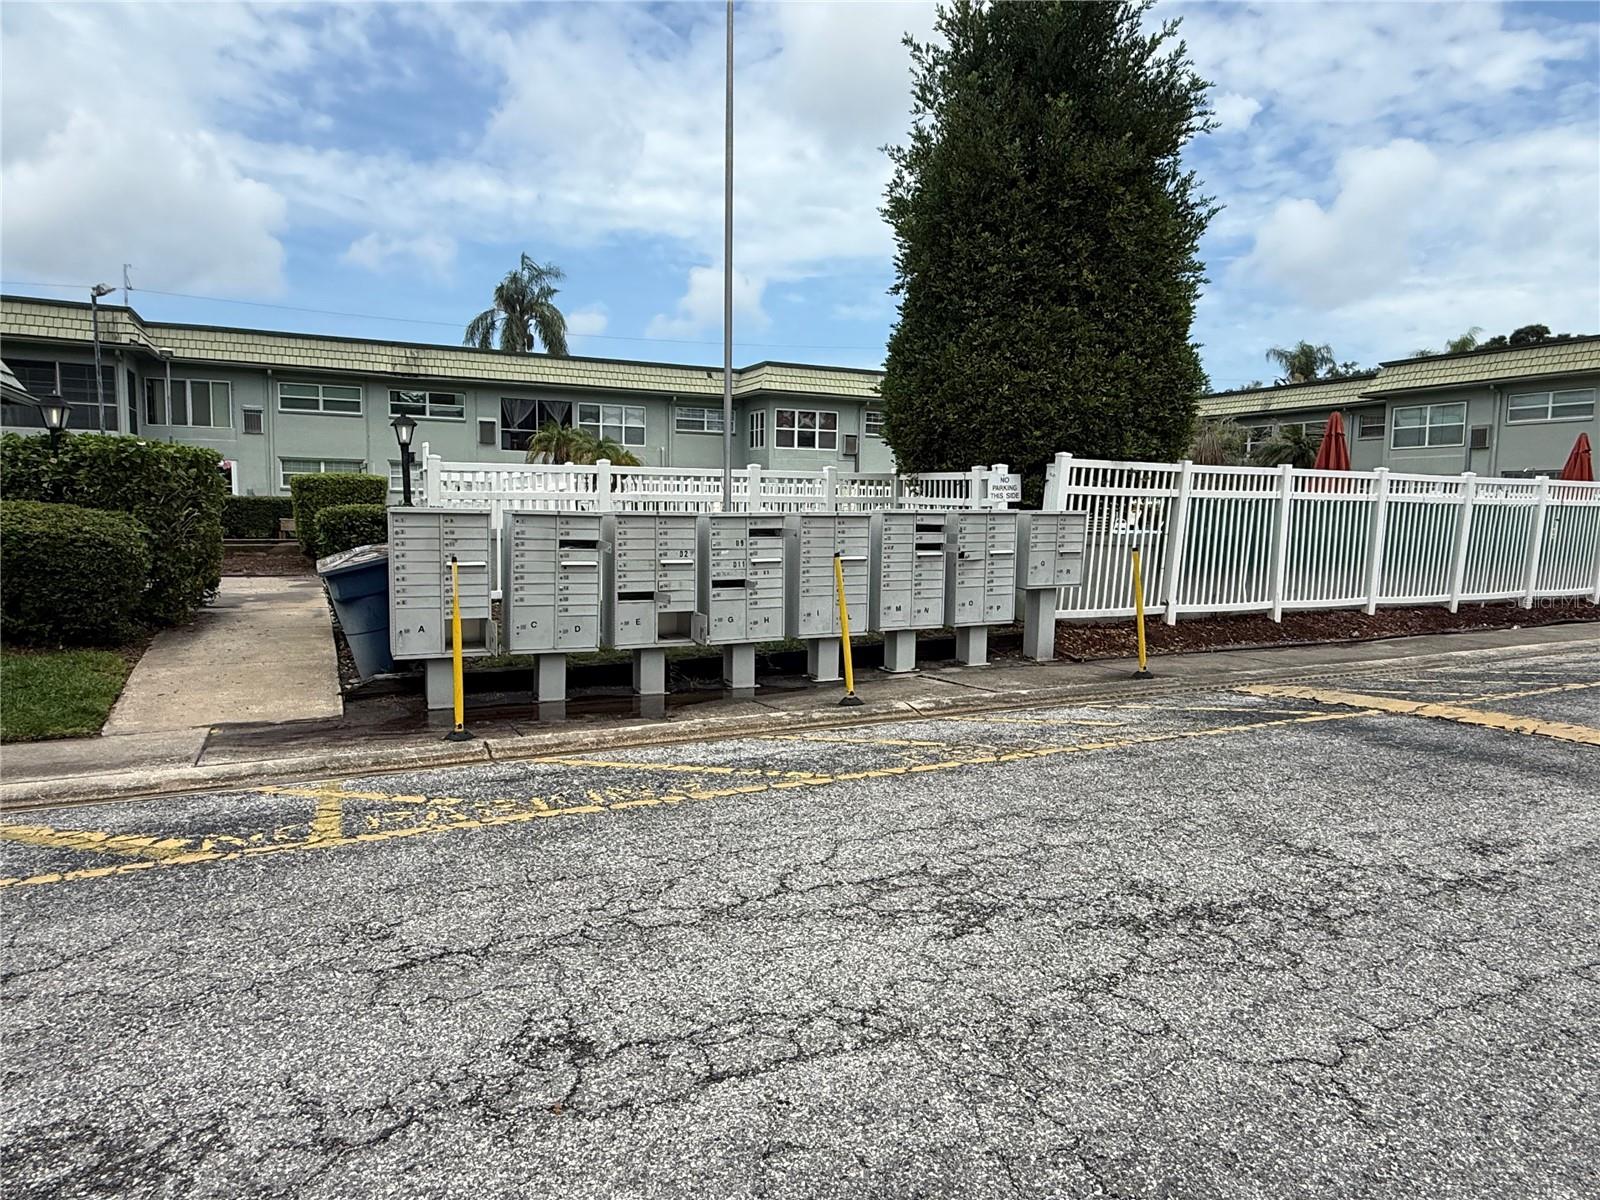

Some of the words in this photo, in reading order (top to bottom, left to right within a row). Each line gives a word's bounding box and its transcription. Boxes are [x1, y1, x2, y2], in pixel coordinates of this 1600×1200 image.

[635, 618, 641, 626] E
[763, 616, 770, 624] H
[530, 620, 538, 629] C
[417, 625, 425, 633] A
[574, 625, 581, 633] D
